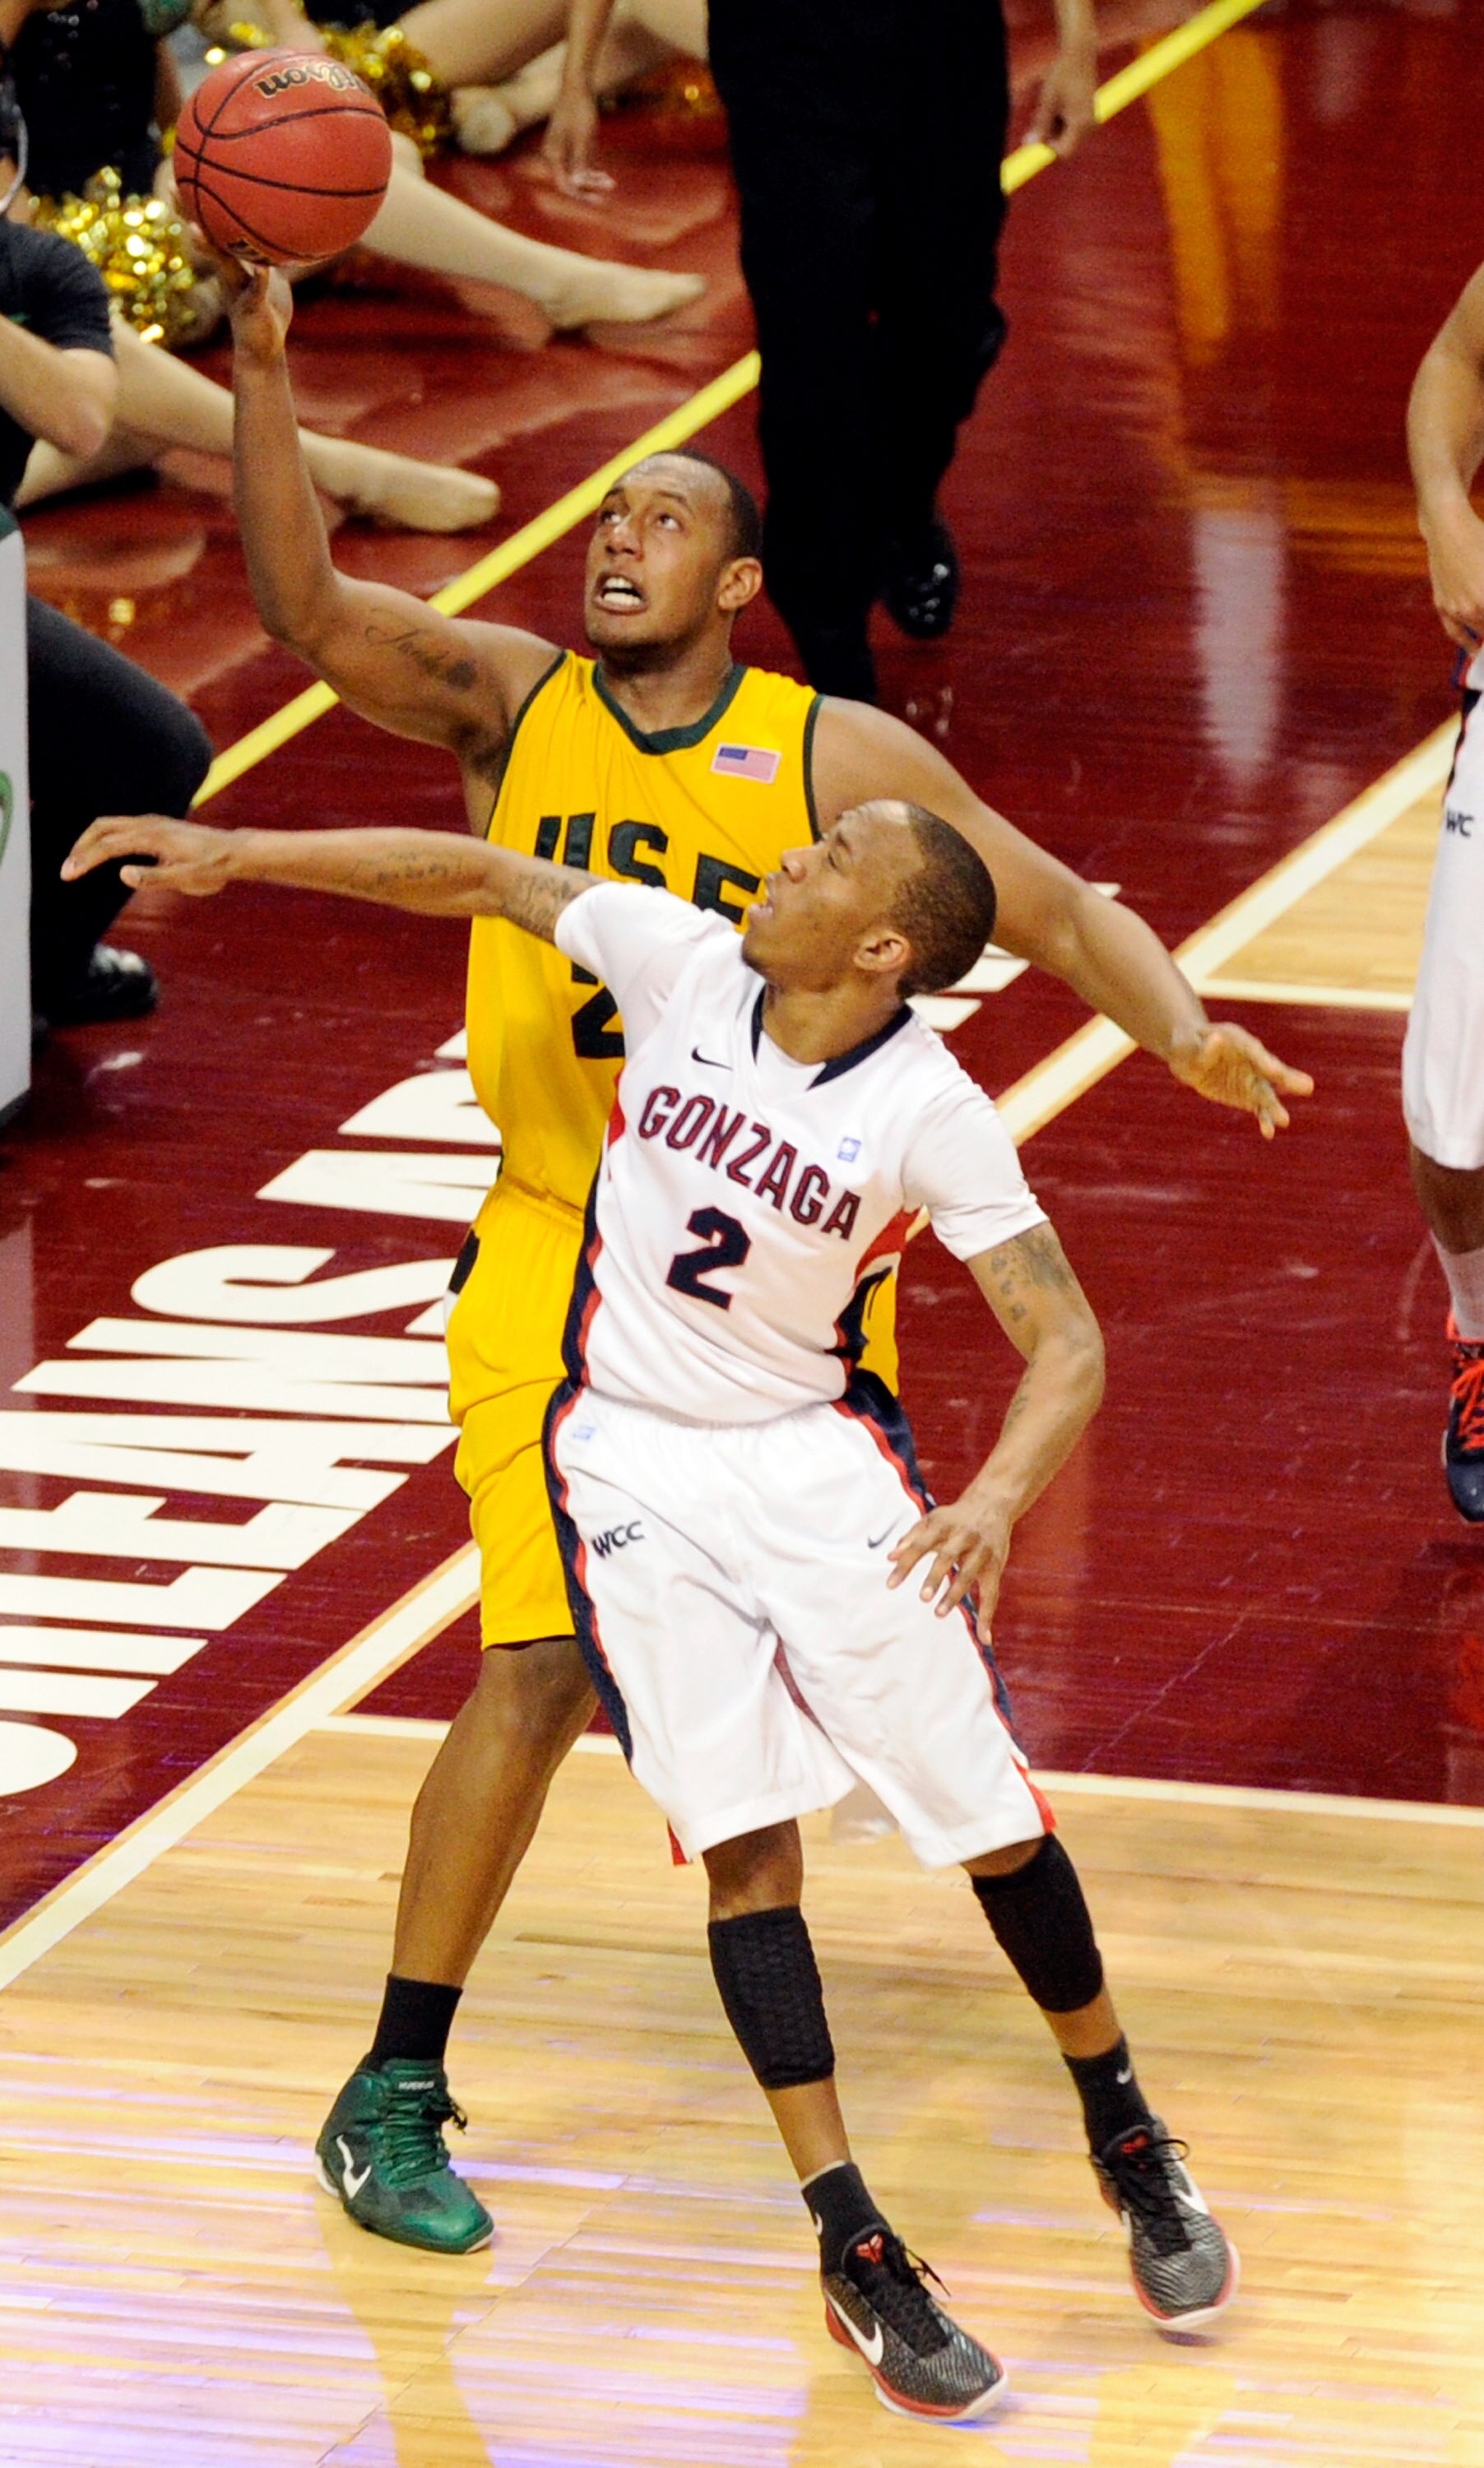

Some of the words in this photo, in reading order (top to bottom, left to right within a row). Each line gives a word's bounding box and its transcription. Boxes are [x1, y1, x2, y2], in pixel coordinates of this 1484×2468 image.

[638, 1086, 861, 1241] GONZAGA
[665, 1206, 752, 1311] 2
[0, 1245, 462, 1796] LEANS
[591, 1521, 645, 1560] WCC
